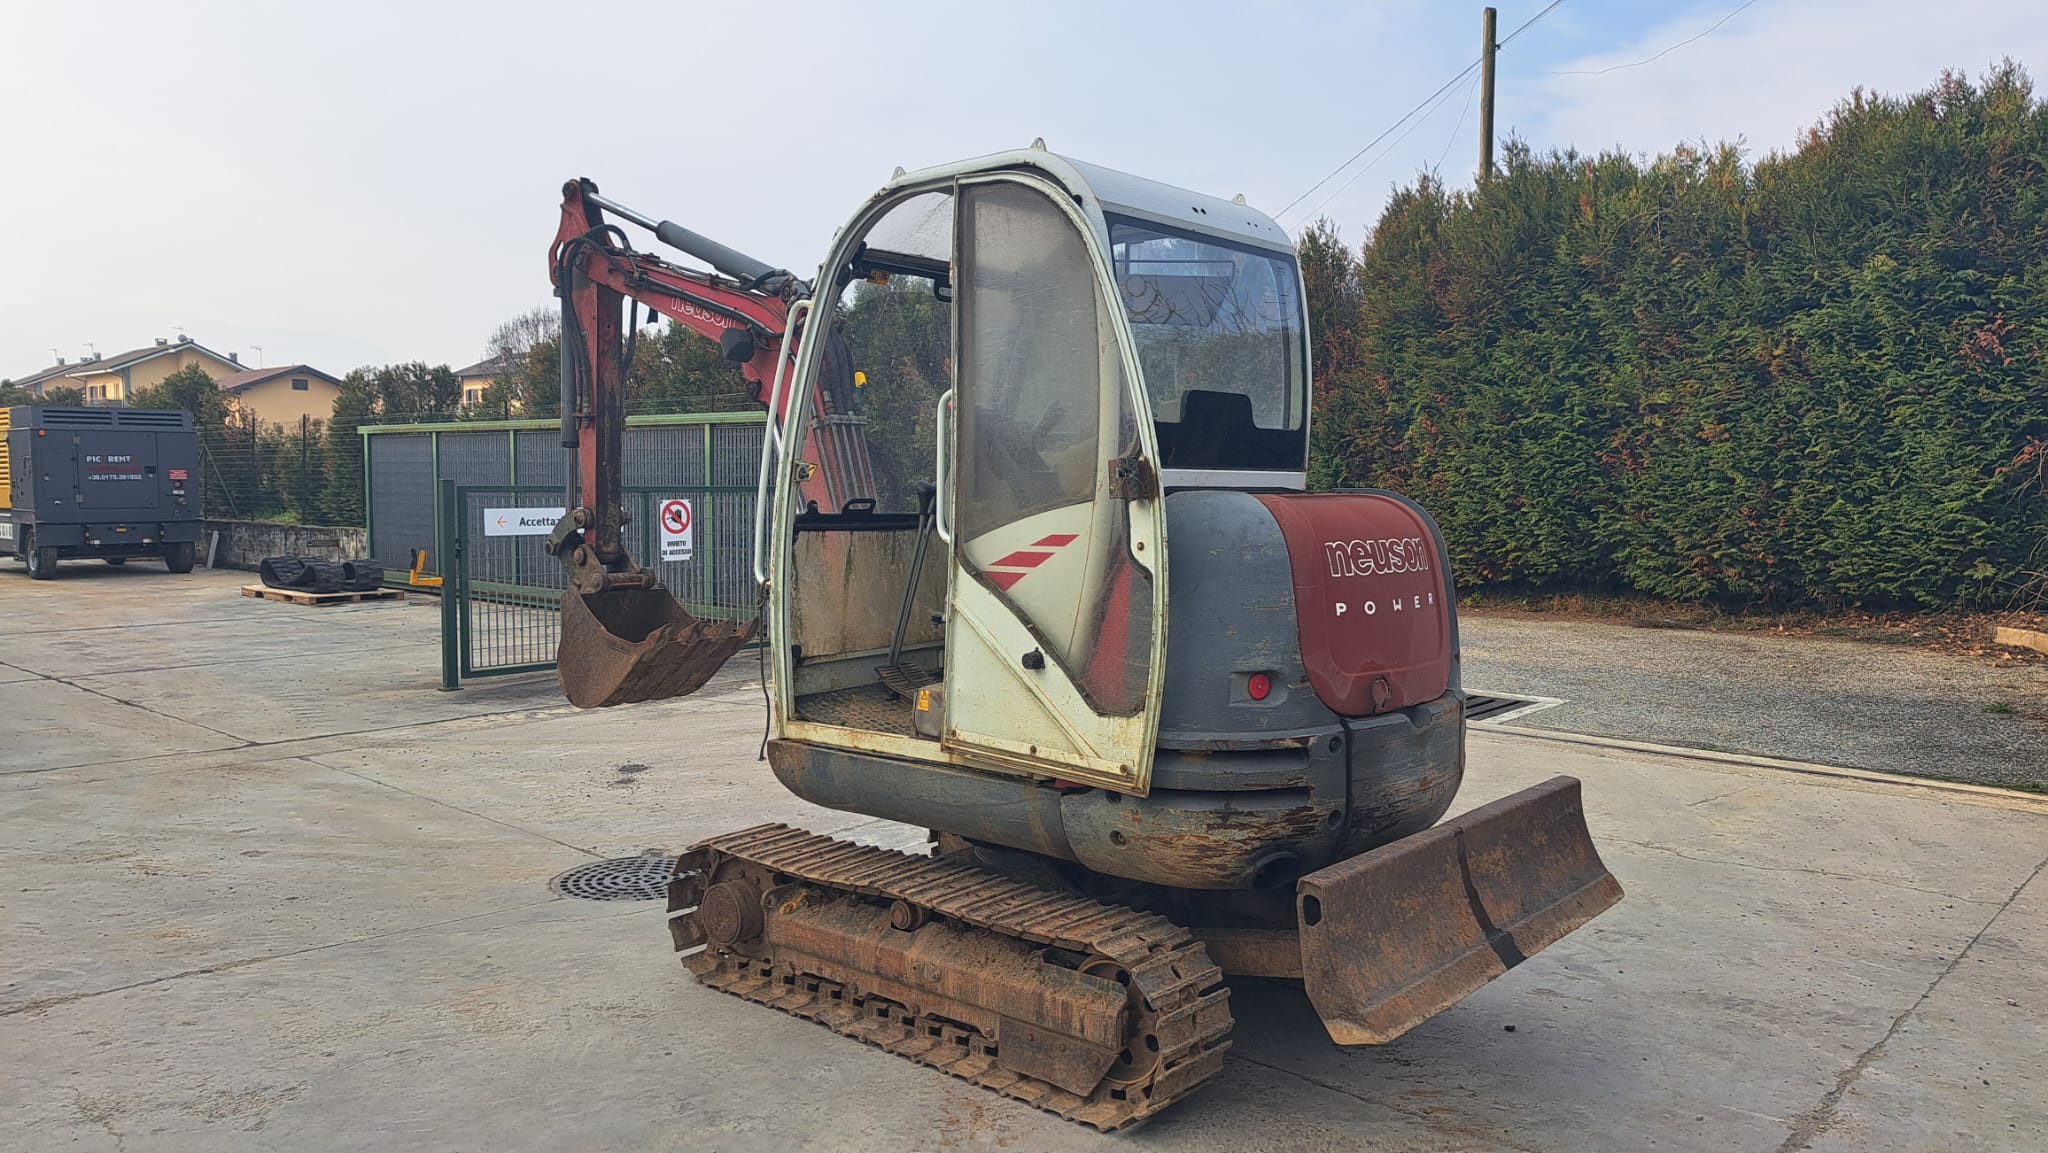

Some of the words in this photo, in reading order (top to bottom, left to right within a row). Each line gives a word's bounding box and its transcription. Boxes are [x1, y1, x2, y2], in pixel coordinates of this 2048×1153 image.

[86, 455, 102, 463] PIC
[107, 455, 131, 463] RENT
[1325, 537, 1430, 577] neuson
[1335, 592, 1434, 617] POWER
